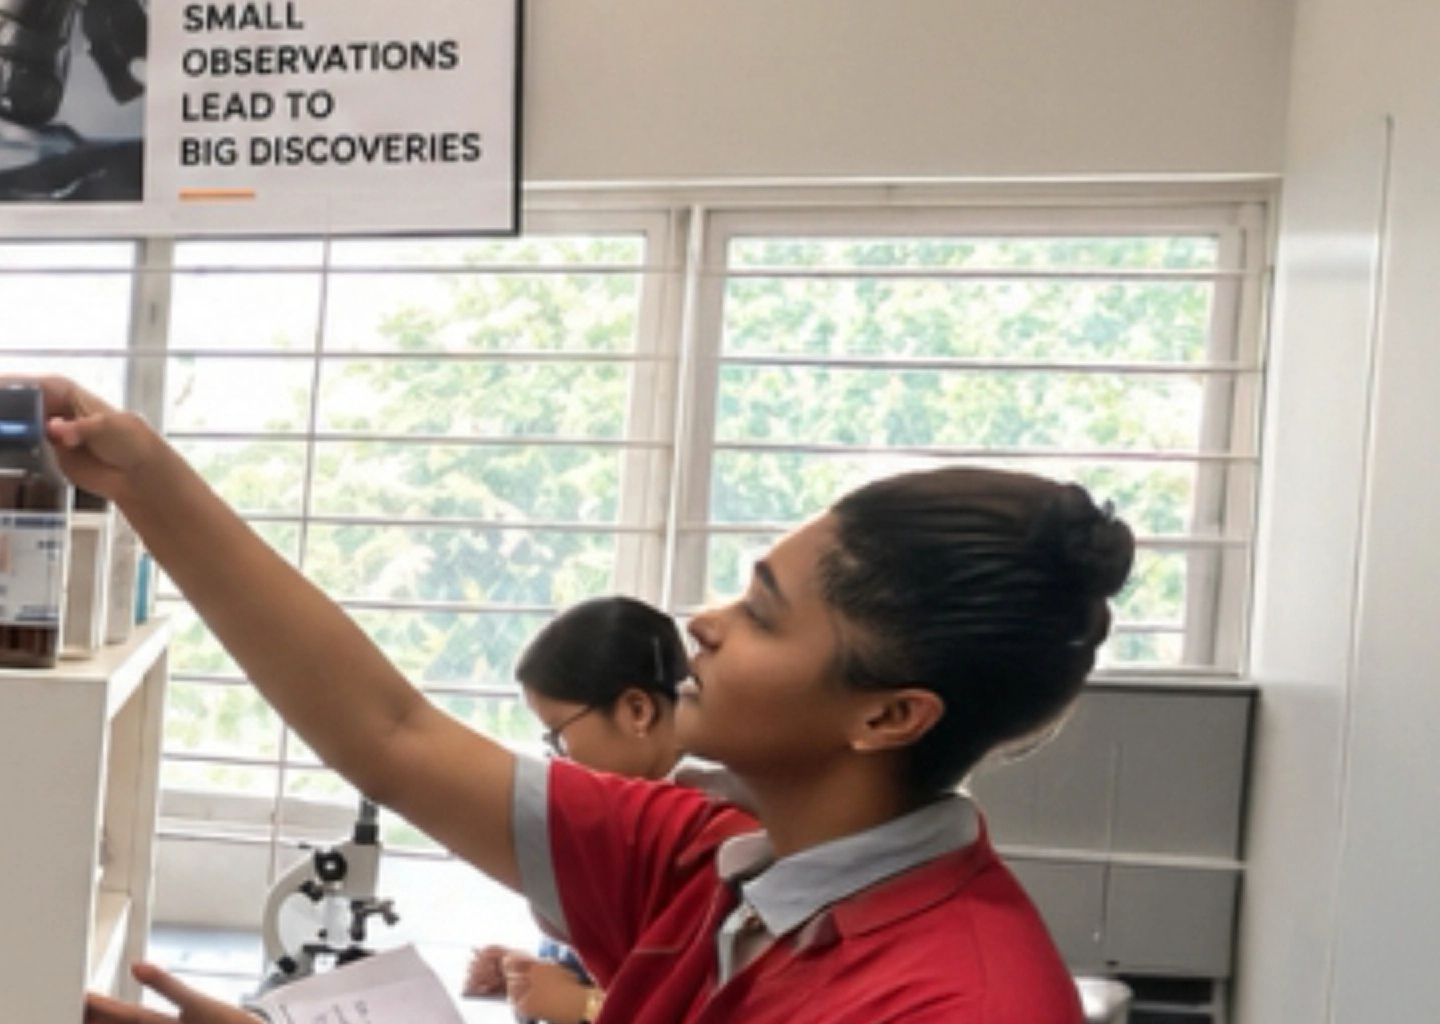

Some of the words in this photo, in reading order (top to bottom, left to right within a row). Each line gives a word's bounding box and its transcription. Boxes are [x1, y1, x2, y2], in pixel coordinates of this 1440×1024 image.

[184, 1, 304, 32] SMALL
[182, 40, 459, 78] OBSERVATIONS
[182, 92, 275, 122] LEAD
[286, 90, 335, 119] TO
[180, 137, 238, 166] BIG
[249, 132, 481, 166] DISCOVERIES
